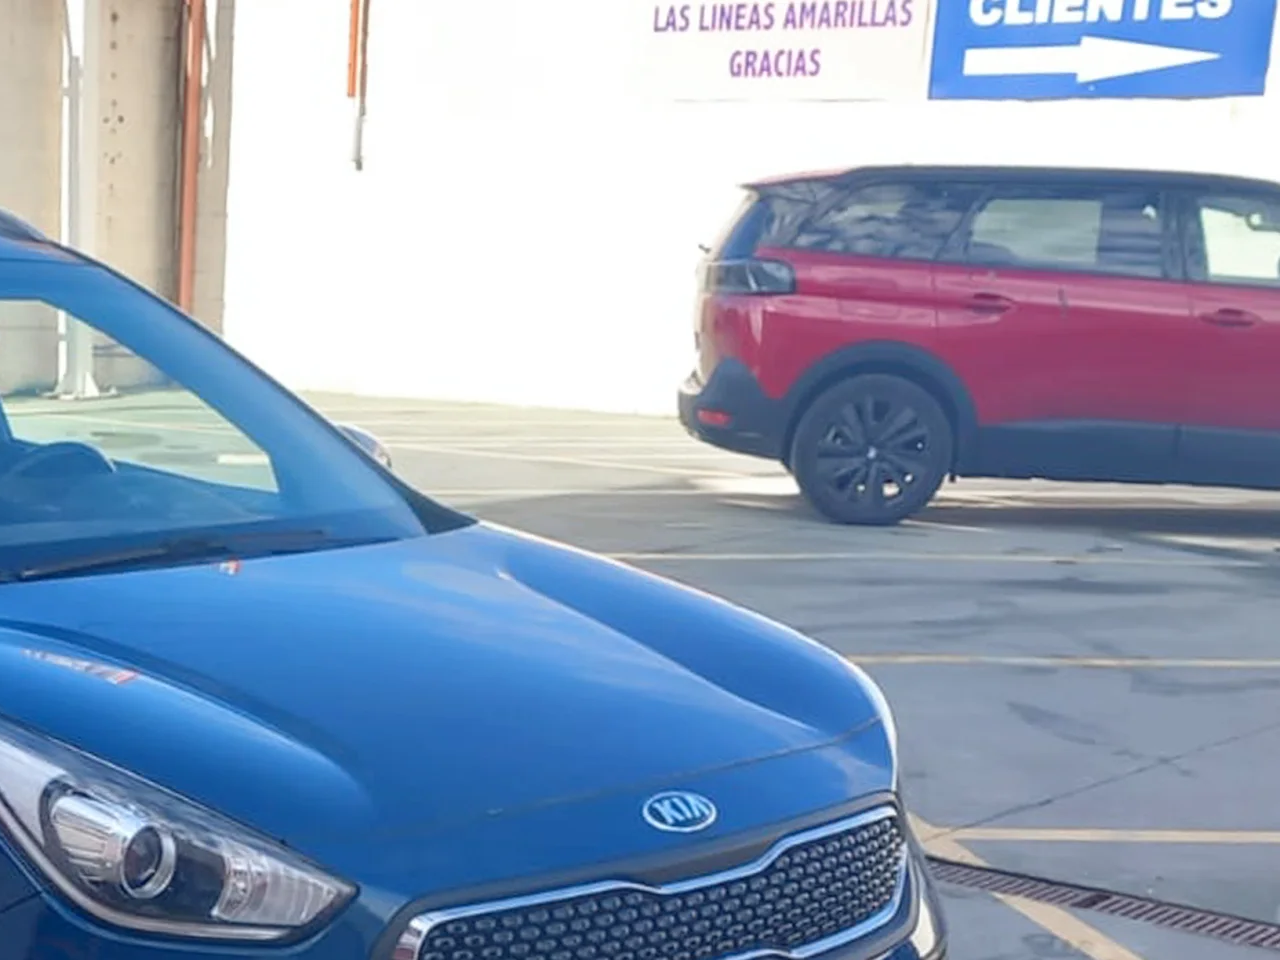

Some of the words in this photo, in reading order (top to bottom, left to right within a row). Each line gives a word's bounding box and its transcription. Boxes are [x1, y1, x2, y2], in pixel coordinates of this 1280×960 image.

[653, 6, 691, 33] LAS
[698, 3, 776, 32] LINEAS
[783, 0, 914, 30] AMARILLAS
[729, 49, 821, 78] GRACIAS
[651, 796, 711, 824] KIA
